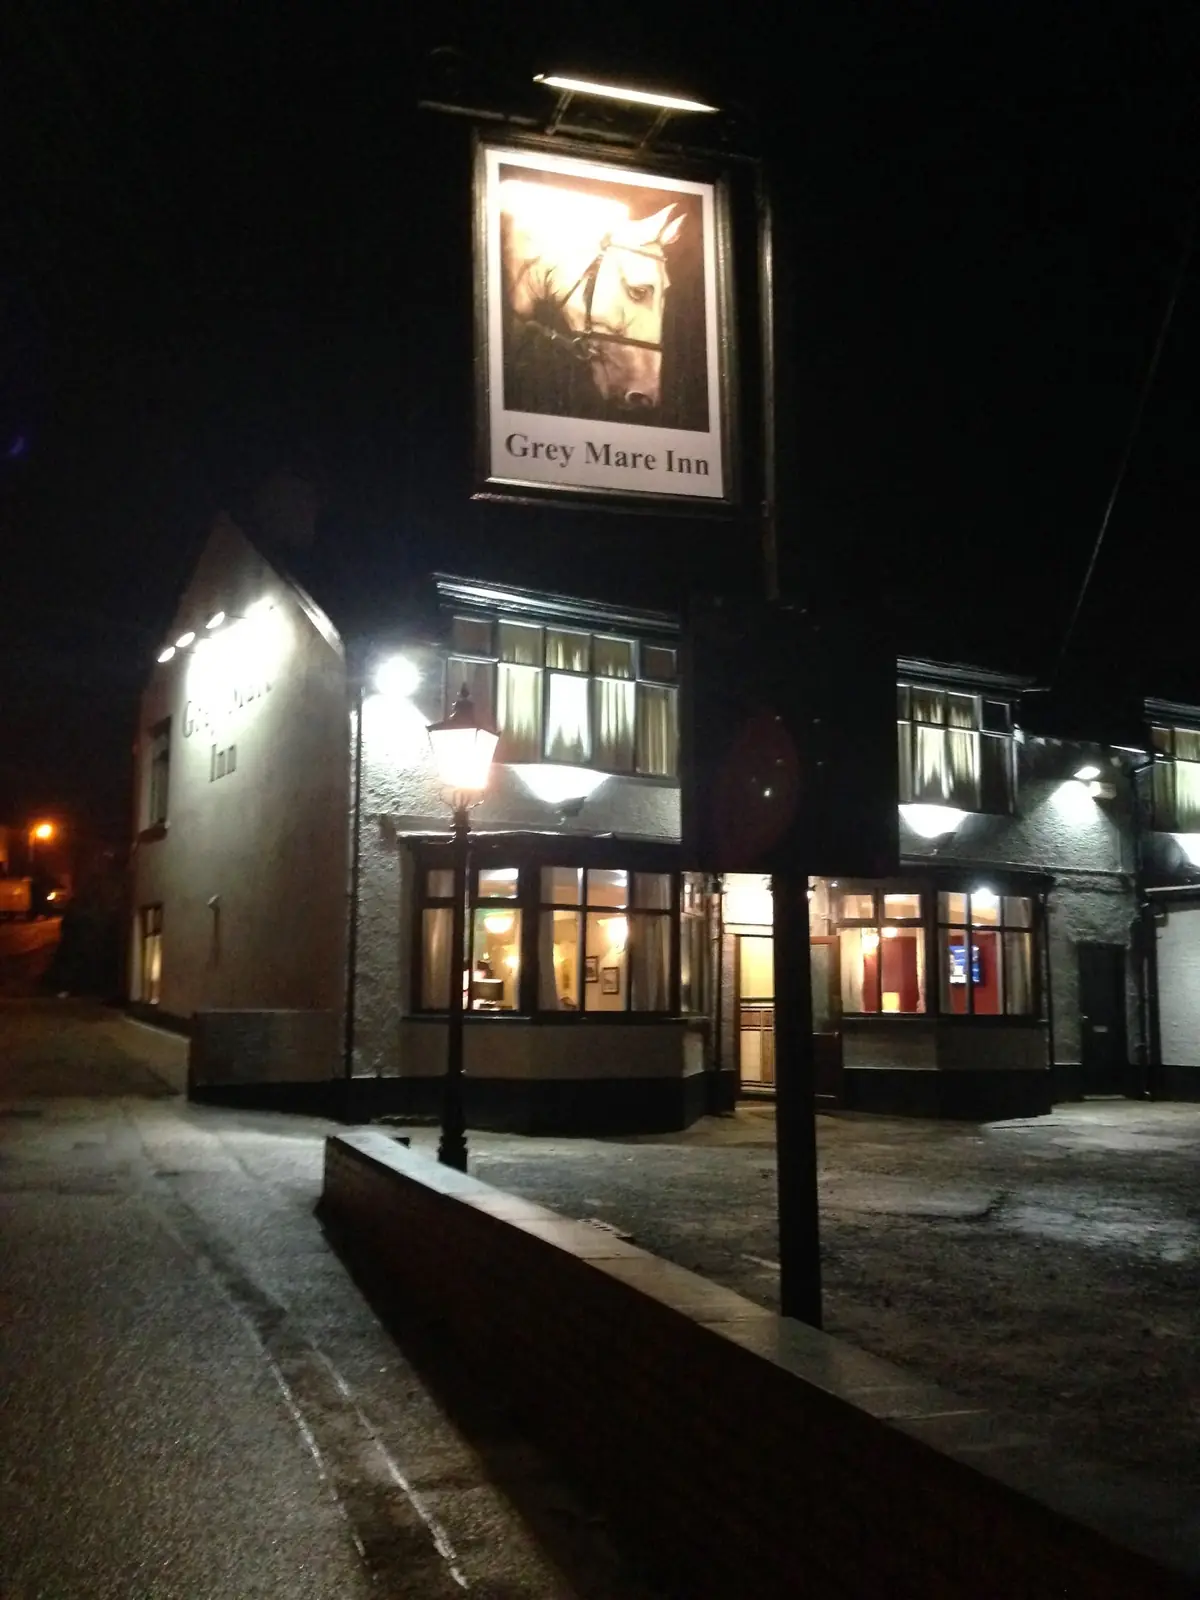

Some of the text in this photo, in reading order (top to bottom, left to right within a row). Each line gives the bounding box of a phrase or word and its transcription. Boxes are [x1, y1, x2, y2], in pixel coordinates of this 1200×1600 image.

[505, 432, 710, 476] Grey Mare Inn
